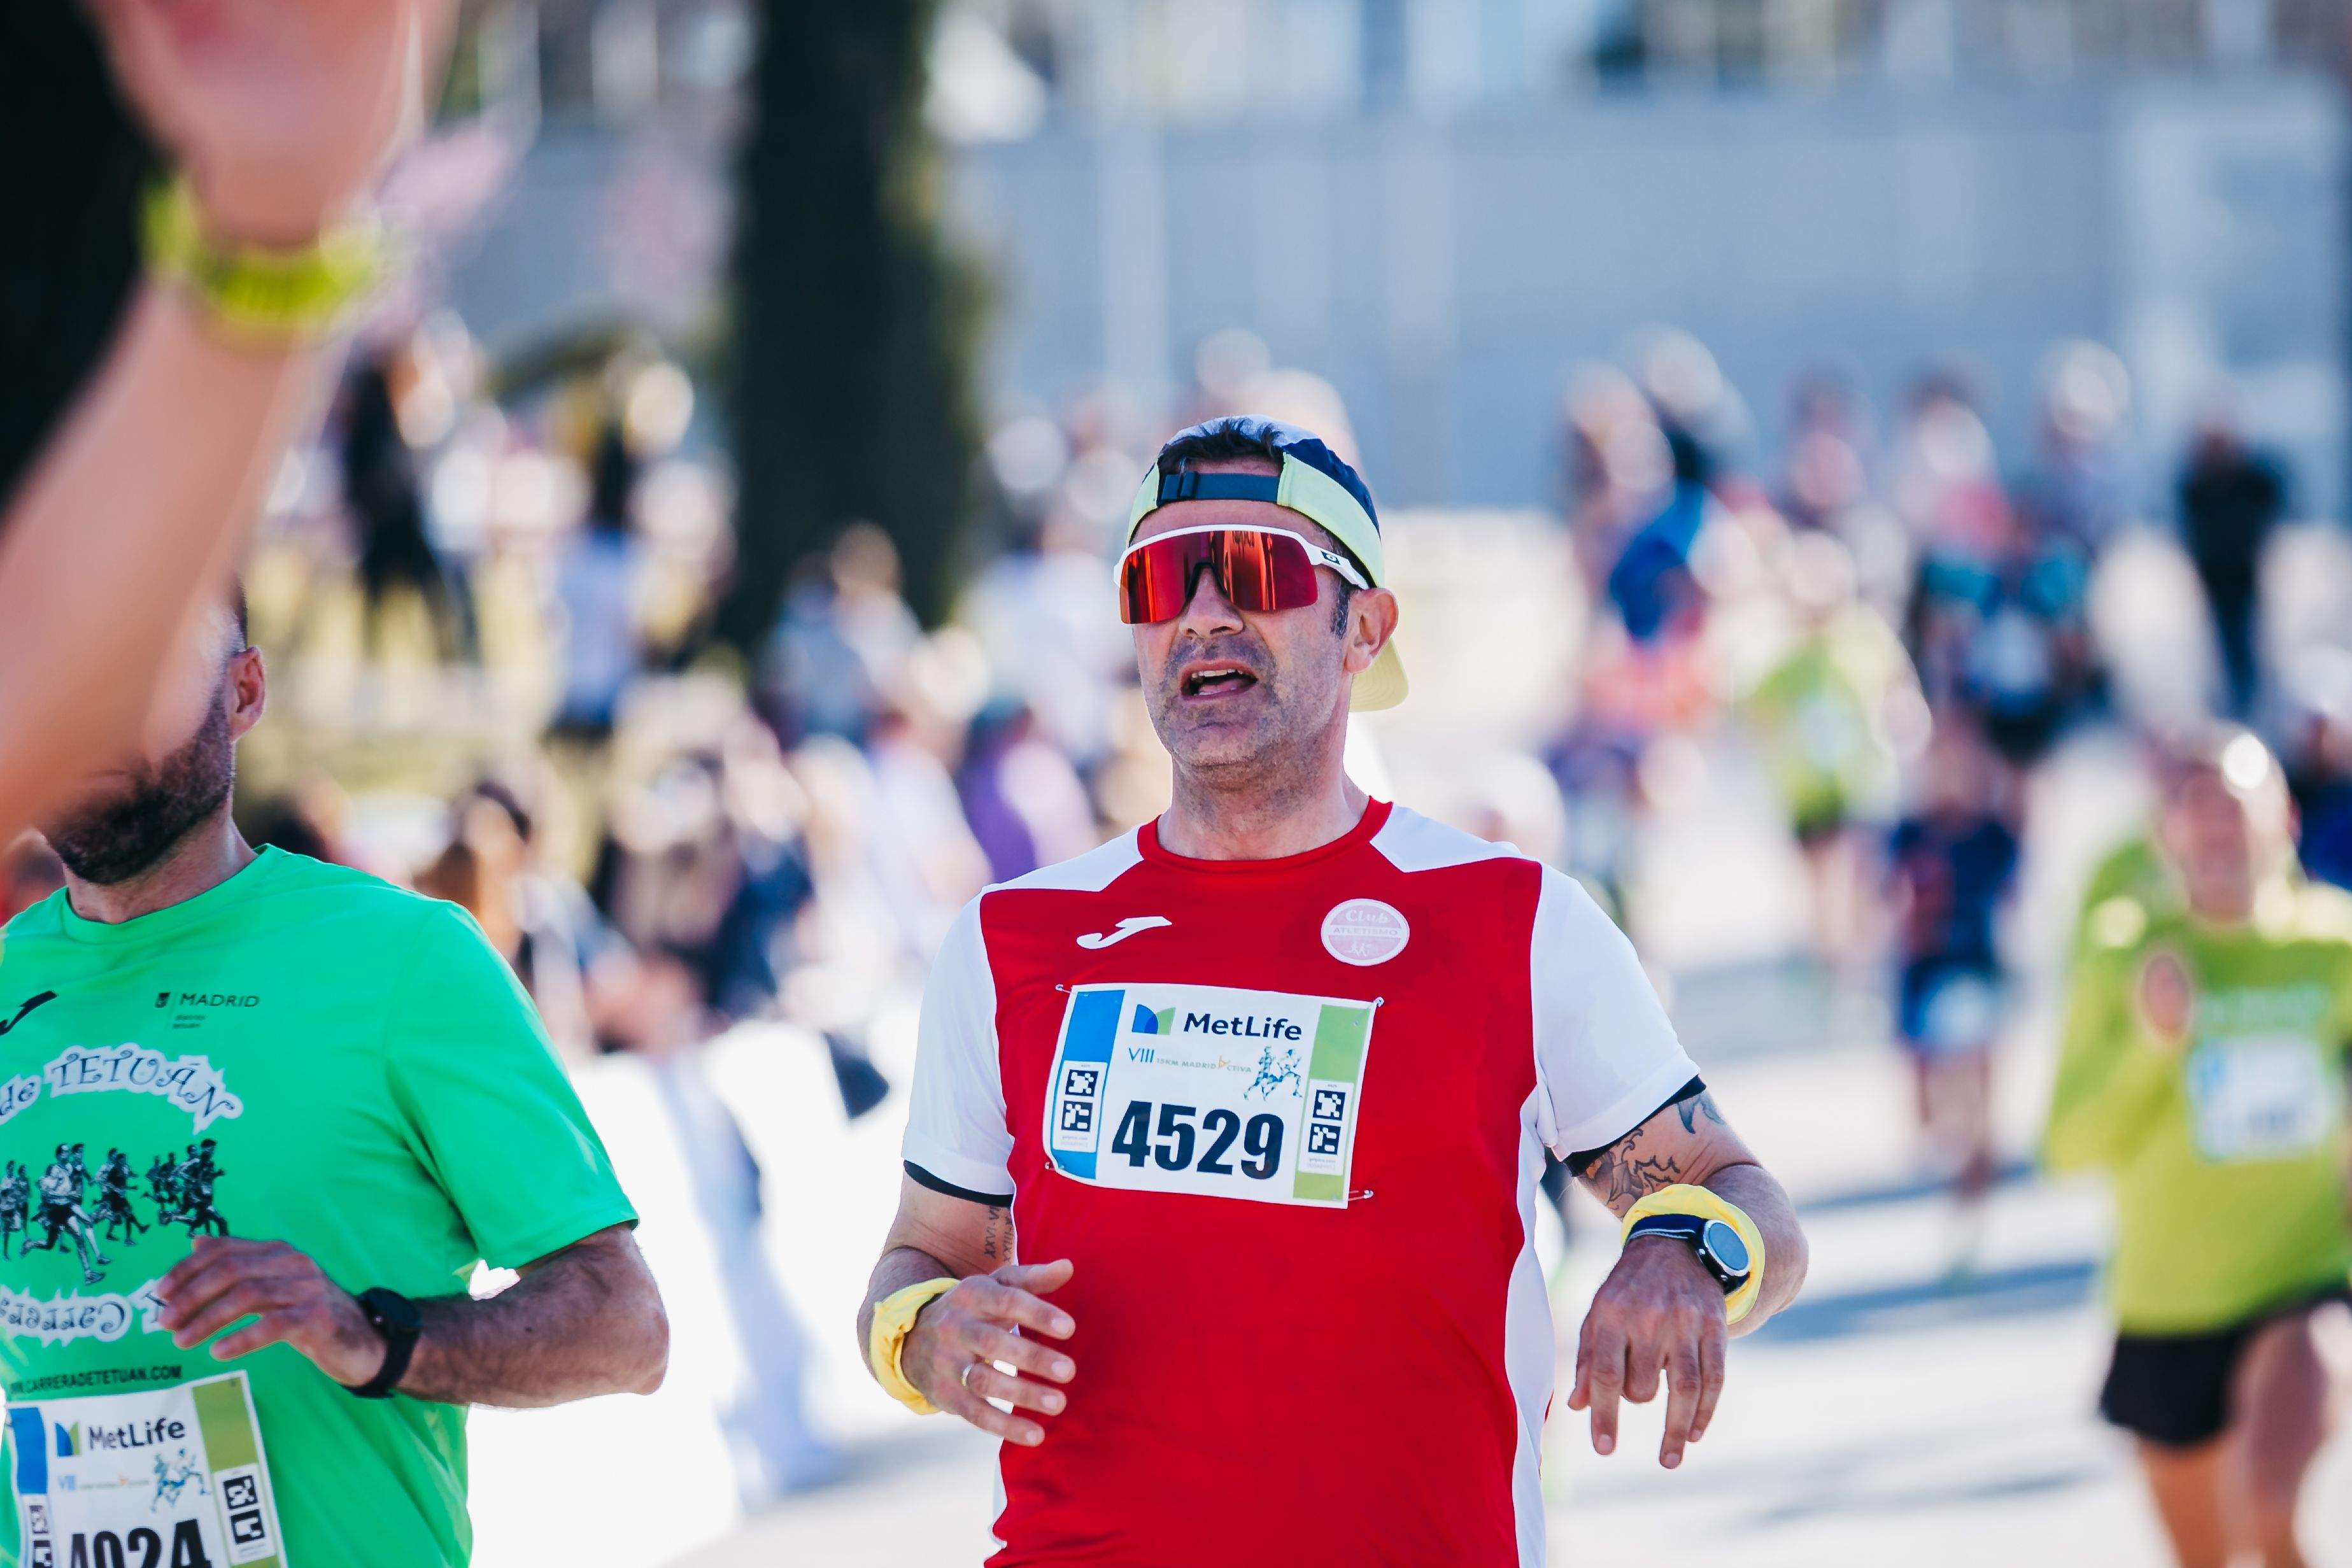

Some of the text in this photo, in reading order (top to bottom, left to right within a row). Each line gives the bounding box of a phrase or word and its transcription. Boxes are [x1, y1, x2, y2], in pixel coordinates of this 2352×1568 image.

[1345, 909, 1389, 924] Club
[1334, 927, 1398, 935] ATLETISMO
[179, 992, 260, 1008] MADRID
[1183, 1012, 1303, 1041] MetLife
[1128, 1047, 1154, 1063] VIII
[1182, 1061, 1217, 1070] MADRID
[1111, 1099, 1286, 1180] 4529
[88, 1415, 186, 1451] MetLife
